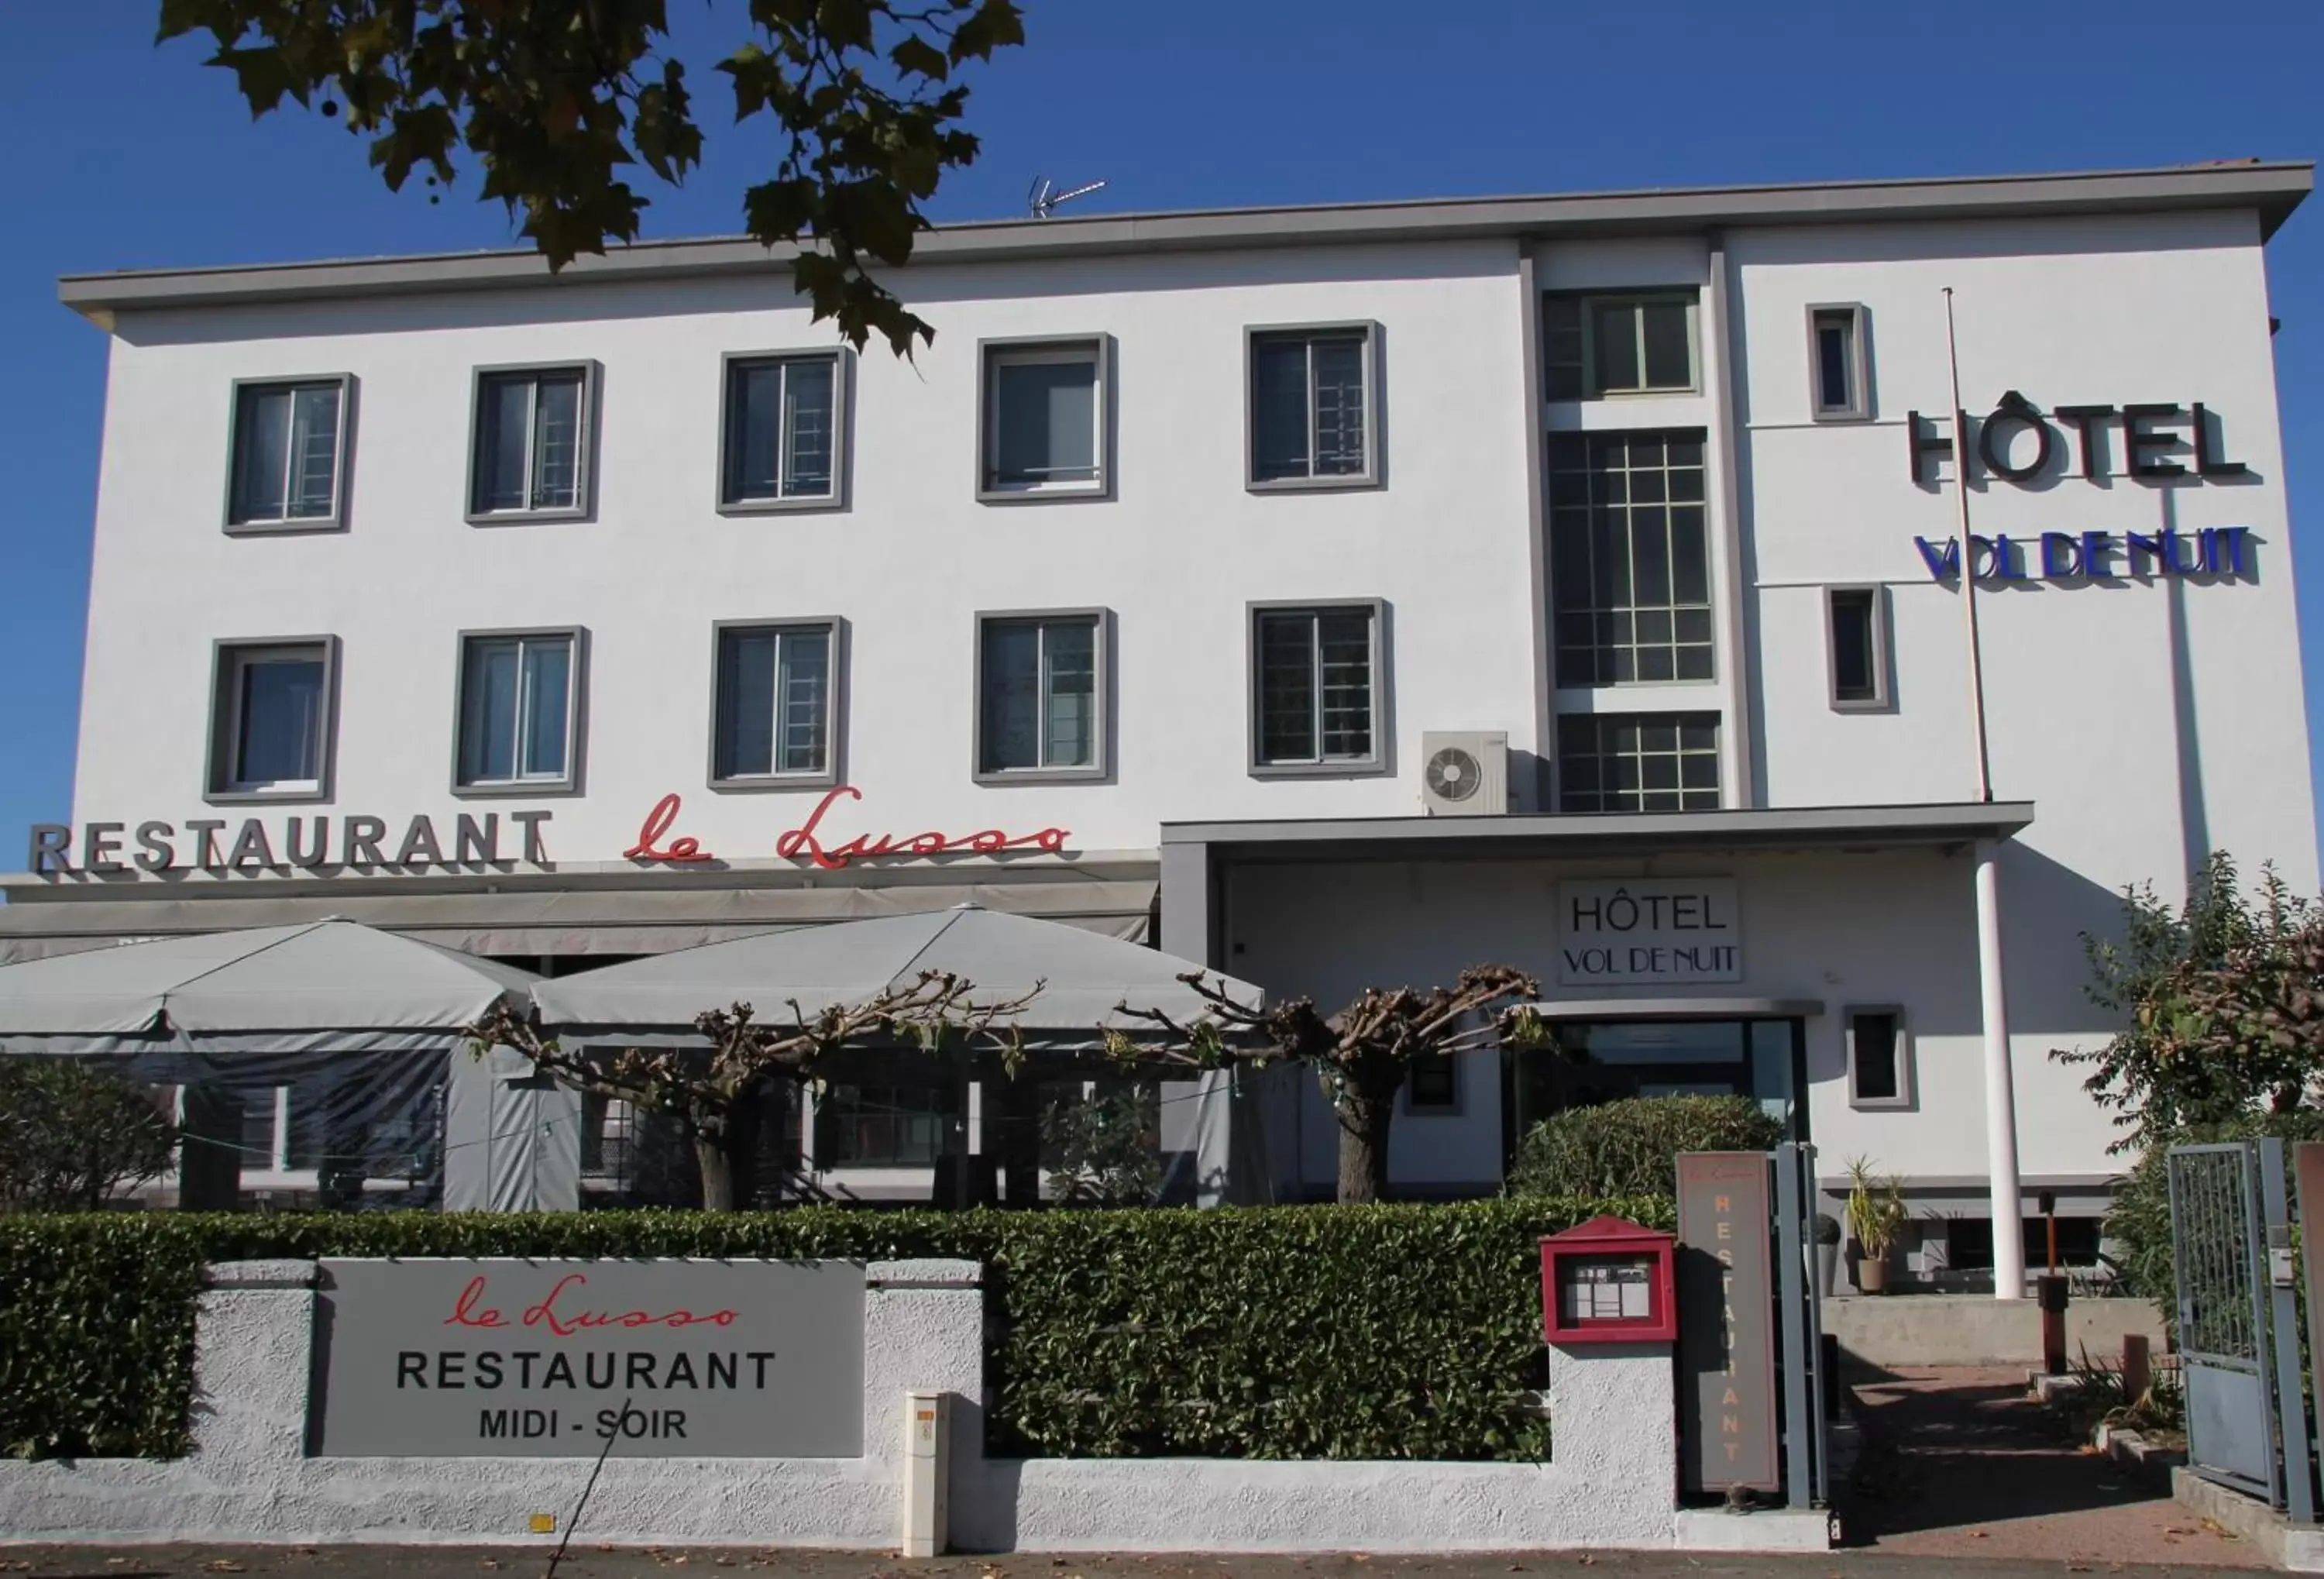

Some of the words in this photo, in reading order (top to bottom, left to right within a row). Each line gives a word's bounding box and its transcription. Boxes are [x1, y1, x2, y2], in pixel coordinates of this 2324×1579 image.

[1908, 390, 2247, 482] HÔTEL
[1913, 533, 2027, 581] VOL
[2040, 530, 2113, 580] DE
[2126, 526, 2249, 575] NUIT
[28, 810, 553, 873] RESTAURANT
[623, 793, 712, 861] le
[776, 786, 1071, 869] Lusso
[1573, 887, 1728, 931] HÔTEL
[1563, 948, 1621, 973] VOL
[1629, 948, 1666, 972] DE
[1672, 946, 1738, 972] NUIT
[443, 1275, 511, 1327] le
[523, 1274, 741, 1336] Lusso
[397, 1350, 776, 1391] RESTAURANT
[479, 1409, 558, 1438] MIDI
[595, 1409, 687, 1439] SOIR
